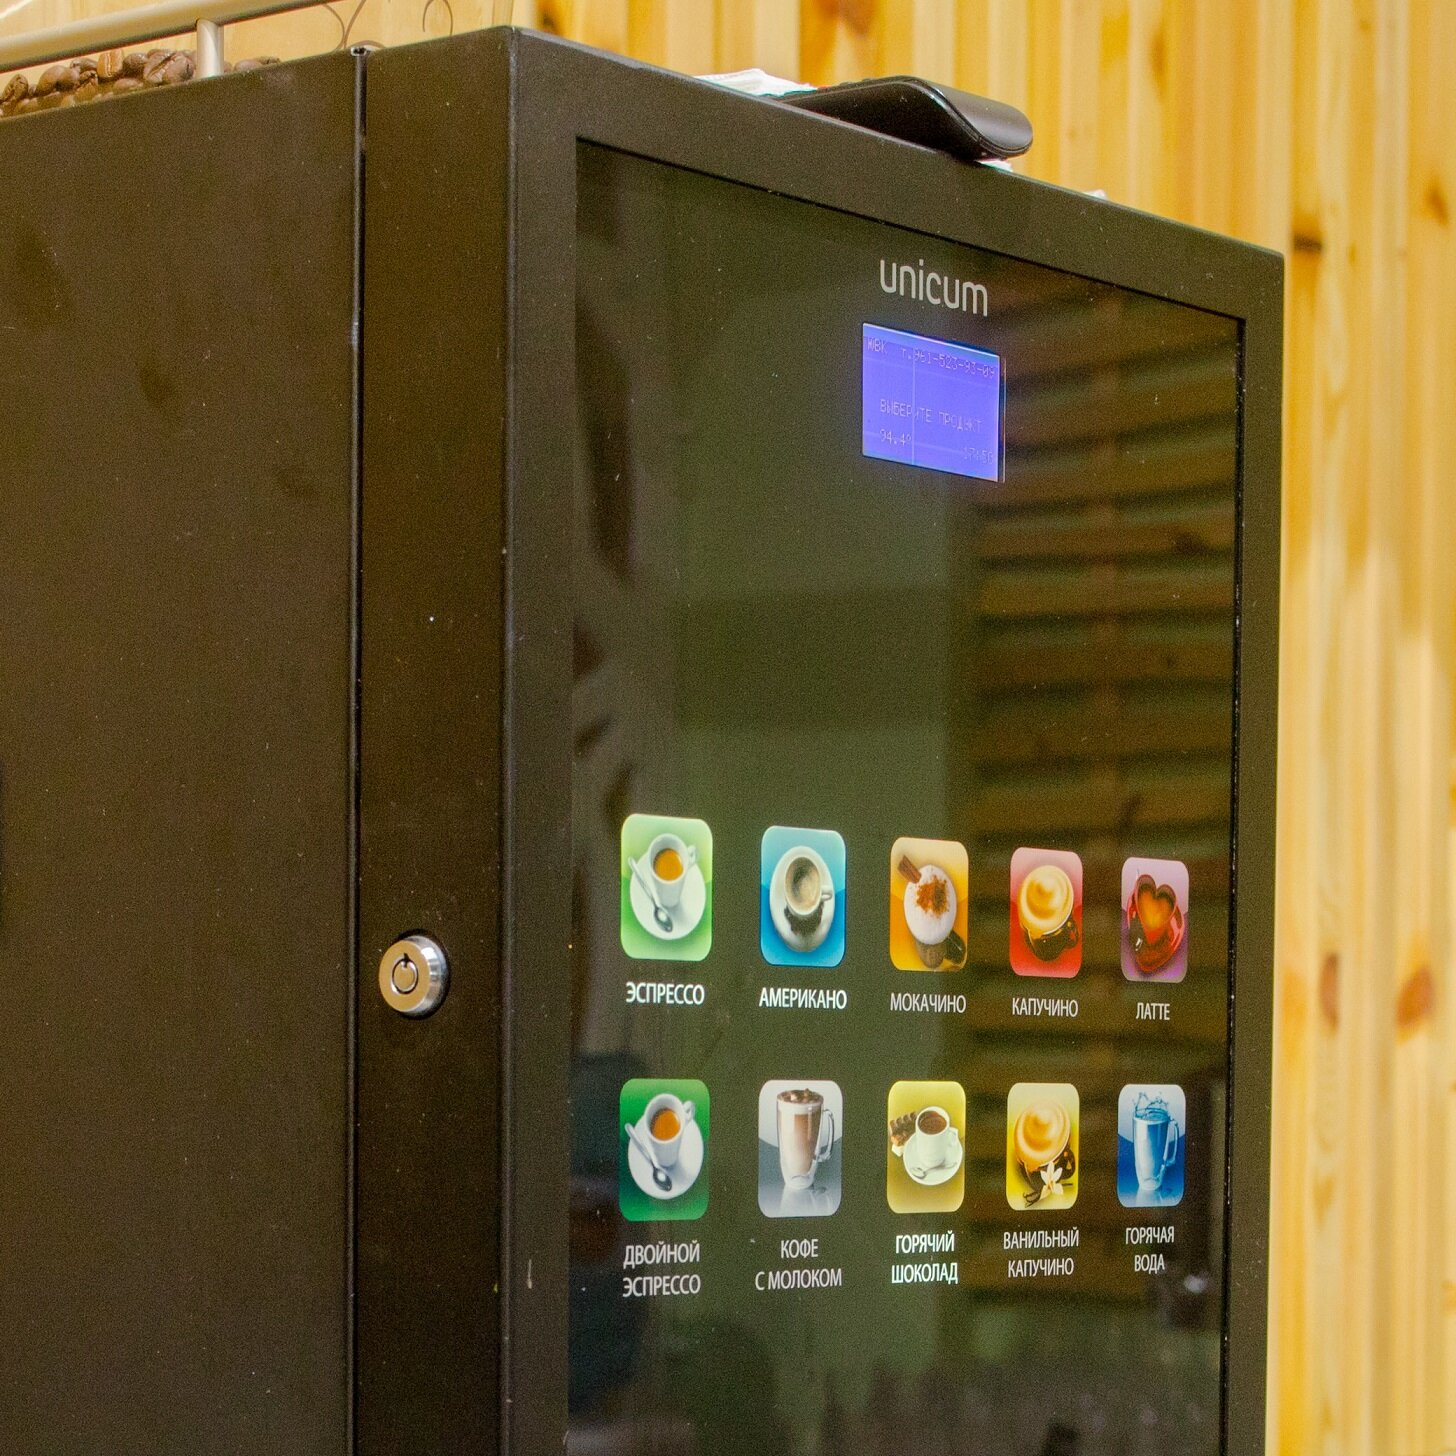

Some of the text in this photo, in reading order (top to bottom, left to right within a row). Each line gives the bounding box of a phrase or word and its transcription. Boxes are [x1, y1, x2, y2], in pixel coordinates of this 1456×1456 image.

[880, 258, 988, 317] unicum
[625, 981, 705, 1005] ЭСПРЕССО
[758, 987, 848, 1010] АМЕРИКАНО
[890, 992, 967, 1014] МОКАЧИНО
[1012, 997, 1079, 1018] КАПУЧИНО
[1135, 1002, 1171, 1021] ЛАТТЕ
[895, 1229, 955, 1254] ГОРЯЧИЙ
[1003, 1226, 1079, 1250] ВАНИЛЬНЫЙ
[1125, 1225, 1175, 1245] ГОРЯЧАЯ
[623, 1241, 700, 1268] ДВОЙНОЙ
[780, 1238, 819, 1259] КОФЕ
[891, 1262, 959, 1285] ШОКОЛАД
[1007, 1257, 1075, 1278] КАПУЧИНО
[1134, 1253, 1166, 1275] ВОДА
[622, 1274, 701, 1298] ЭСПРЕССО
[754, 1268, 842, 1291] С МОЛОКОМ
